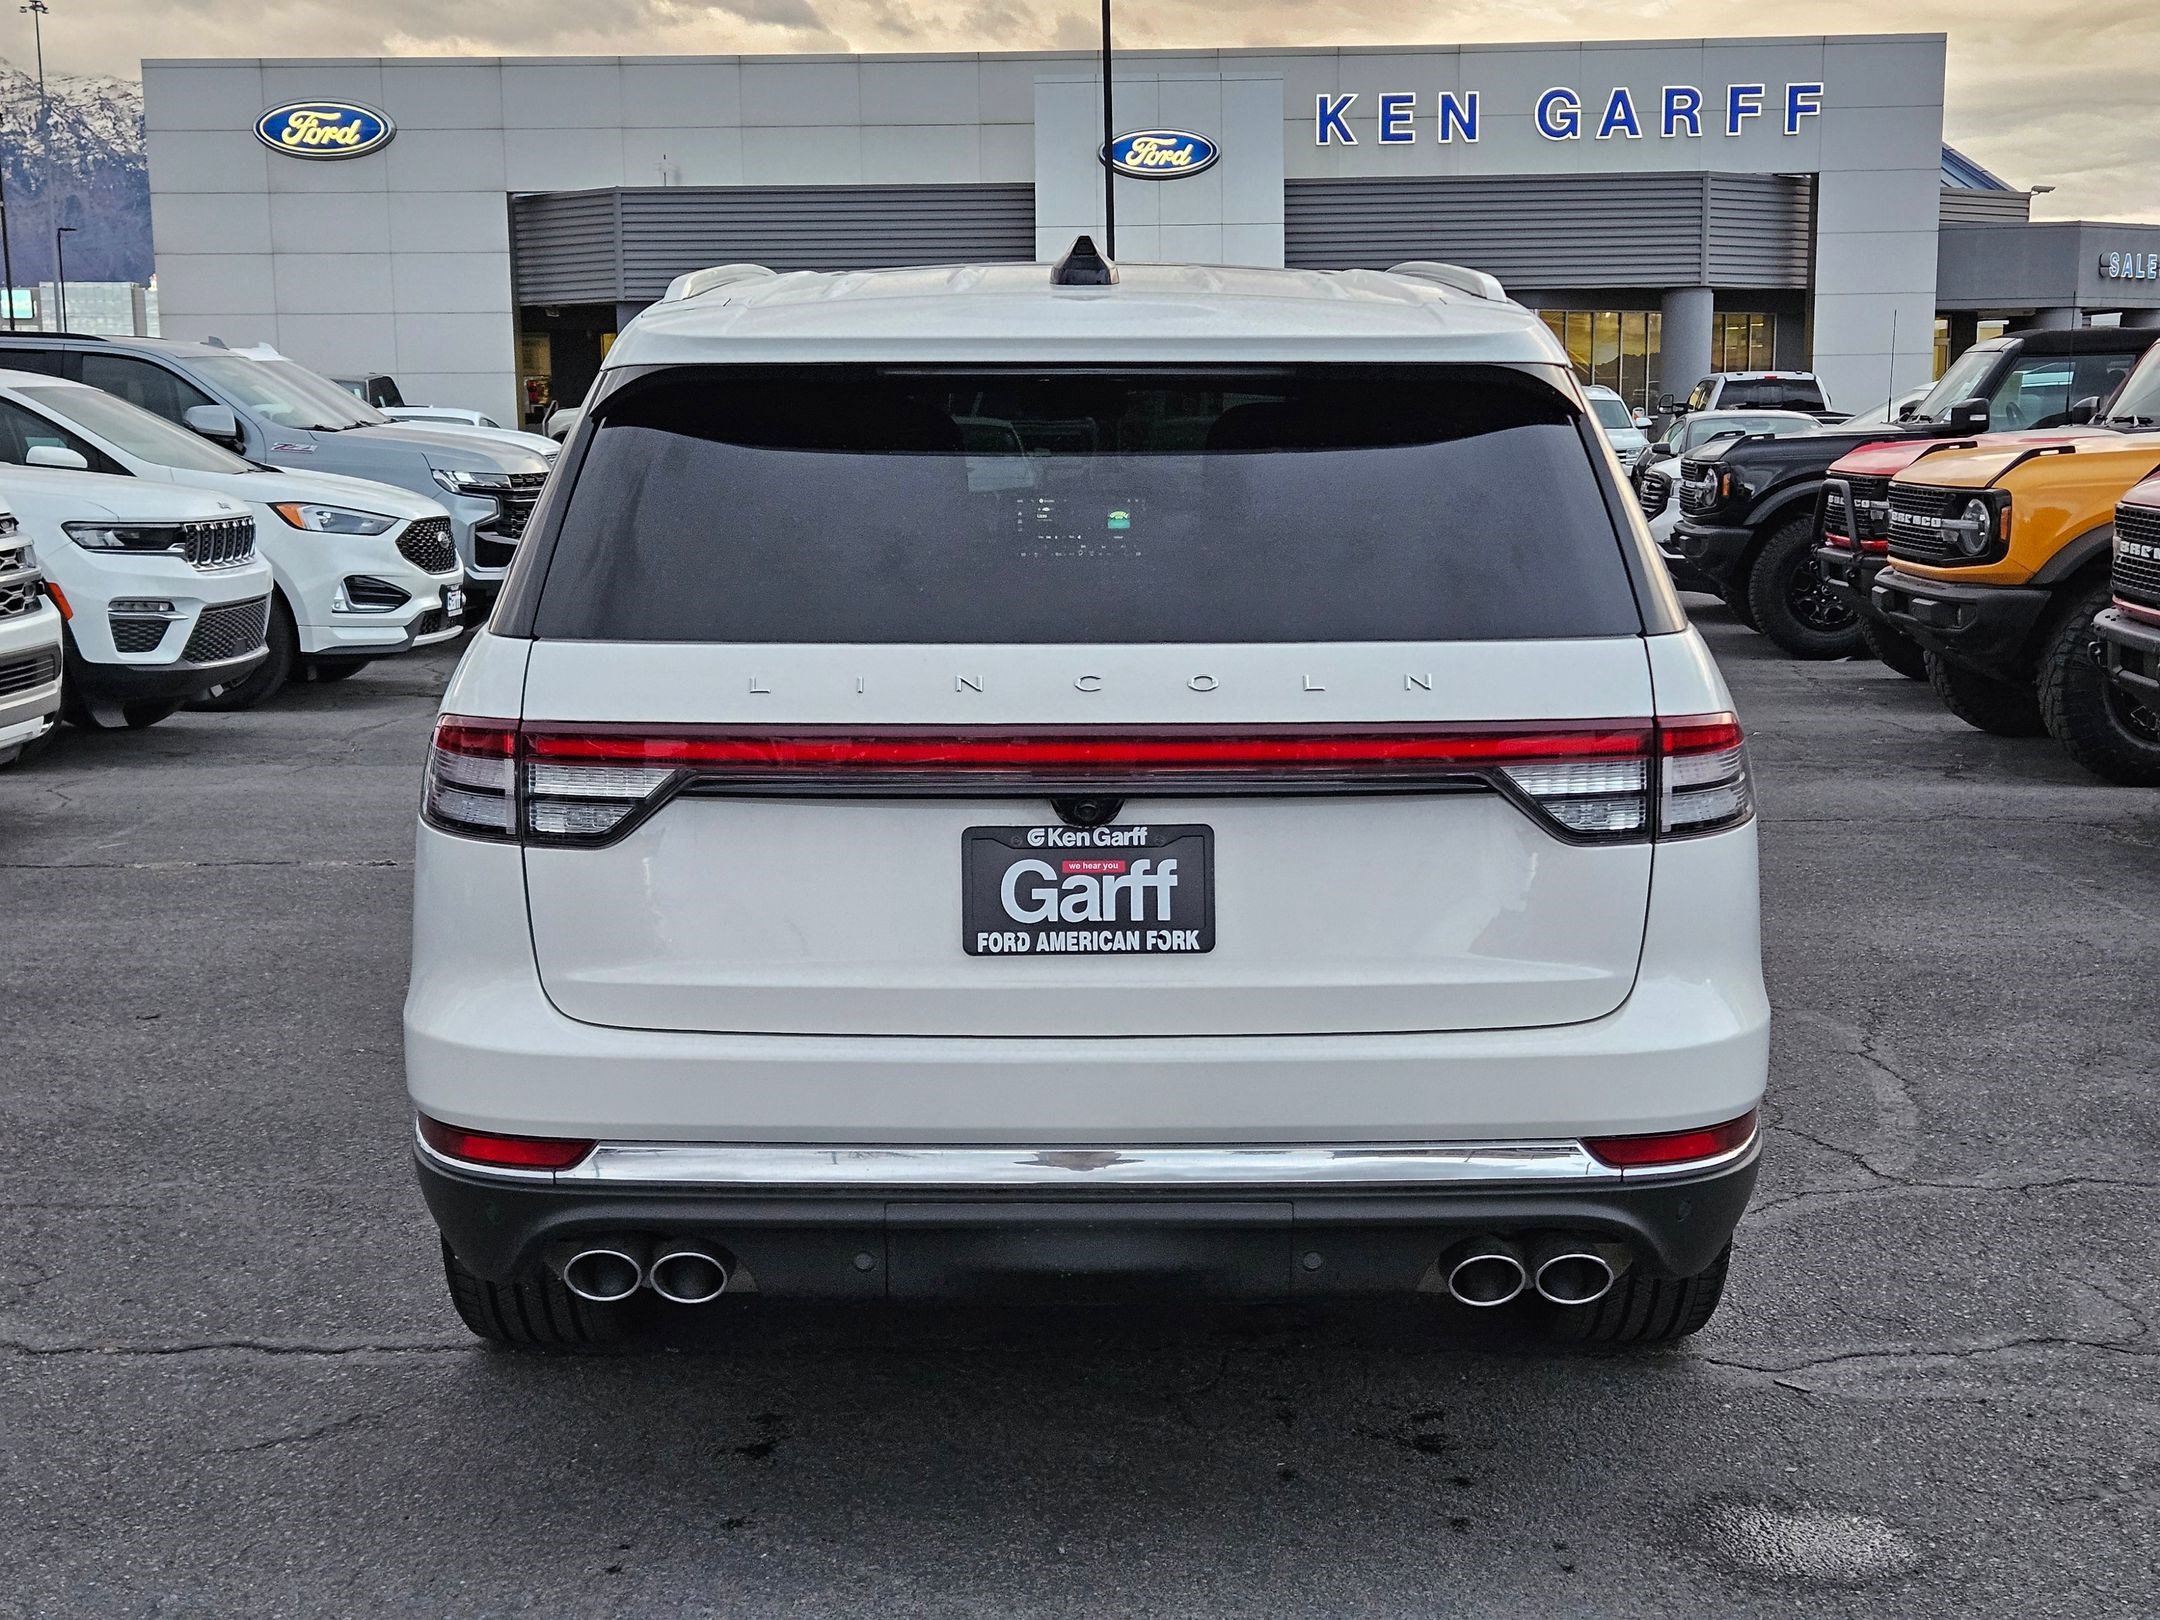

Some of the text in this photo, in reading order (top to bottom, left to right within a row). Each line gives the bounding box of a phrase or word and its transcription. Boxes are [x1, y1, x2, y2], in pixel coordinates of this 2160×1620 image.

[1316, 82, 1824, 146] KEN GARFF
[281, 110, 362, 146] Ford
[1125, 136, 1194, 166] Ford
[1827, 494, 1870, 508] BRCO
[749, 672, 1433, 694] LINCOLN
[1047, 827, 1090, 847] Ken
[1093, 826, 1148, 847] Garff
[1082, 861, 1101, 870] hear
[1102, 863, 1119, 872] you
[1001, 858, 1178, 924] Garff
[977, 930, 1201, 953] FORD AMERICAN FORK
